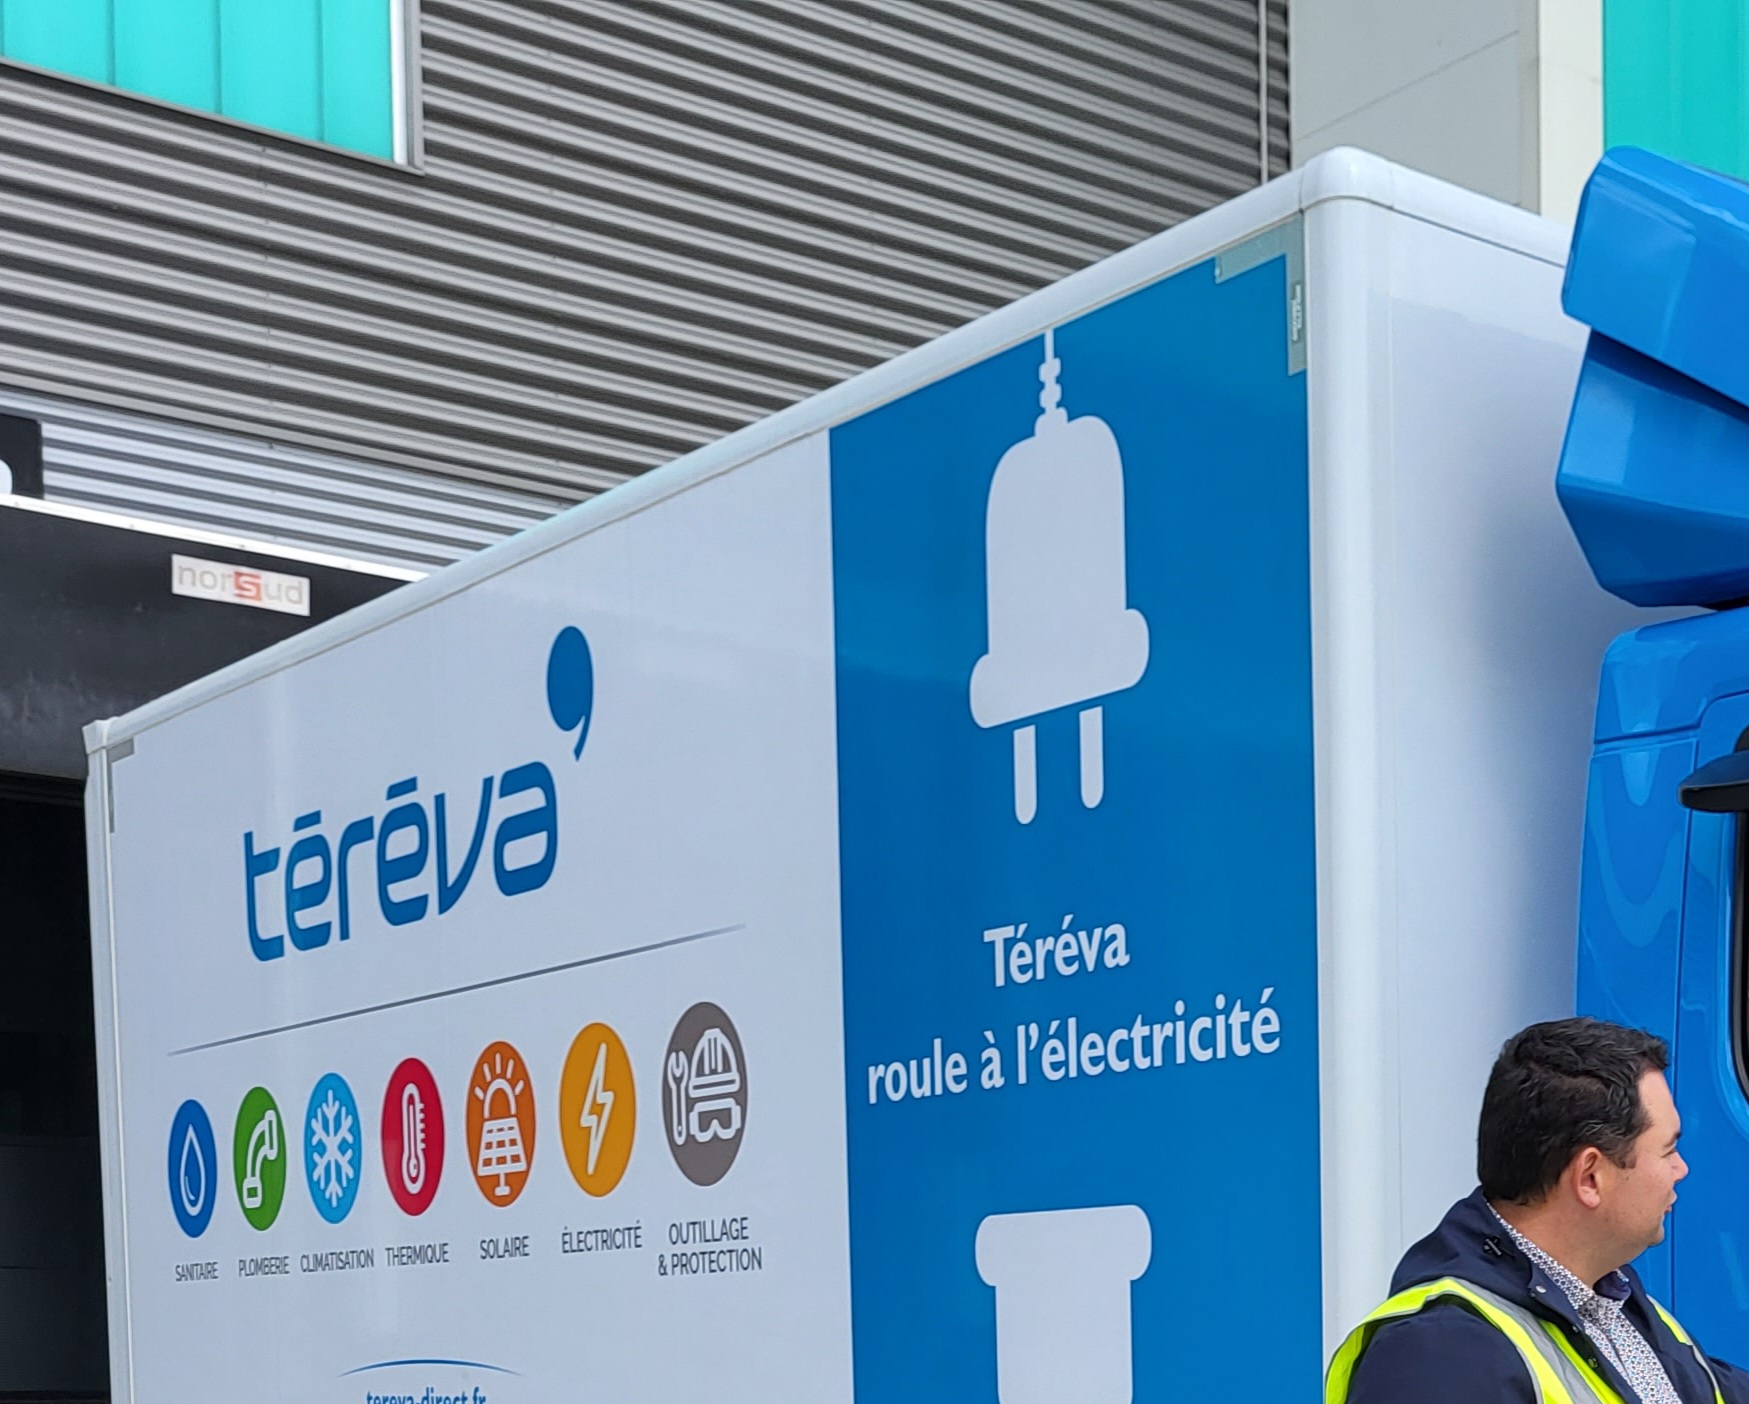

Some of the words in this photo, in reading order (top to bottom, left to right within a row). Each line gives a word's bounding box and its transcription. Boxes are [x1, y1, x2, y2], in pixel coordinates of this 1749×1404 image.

[982, 913, 1131, 988] Téréva
[867, 1037, 968, 1104] roule
[980, 1030, 1005, 1091] à
[561, 1219, 643, 1254] ÉLECTRICITÉ
[668, 1216, 750, 1246] OUTILLAGE
[300, 1248, 375, 1273] CLIMATISATION
[385, 1242, 450, 1267] THERMIQUE
[479, 1235, 530, 1260] SOLAIRE
[657, 1253, 669, 1276] &
[671, 1246, 763, 1276] PROTECTION
[174, 1261, 219, 1282] SANITAIRE
[238, 1255, 290, 1278] PLOMBERIE
